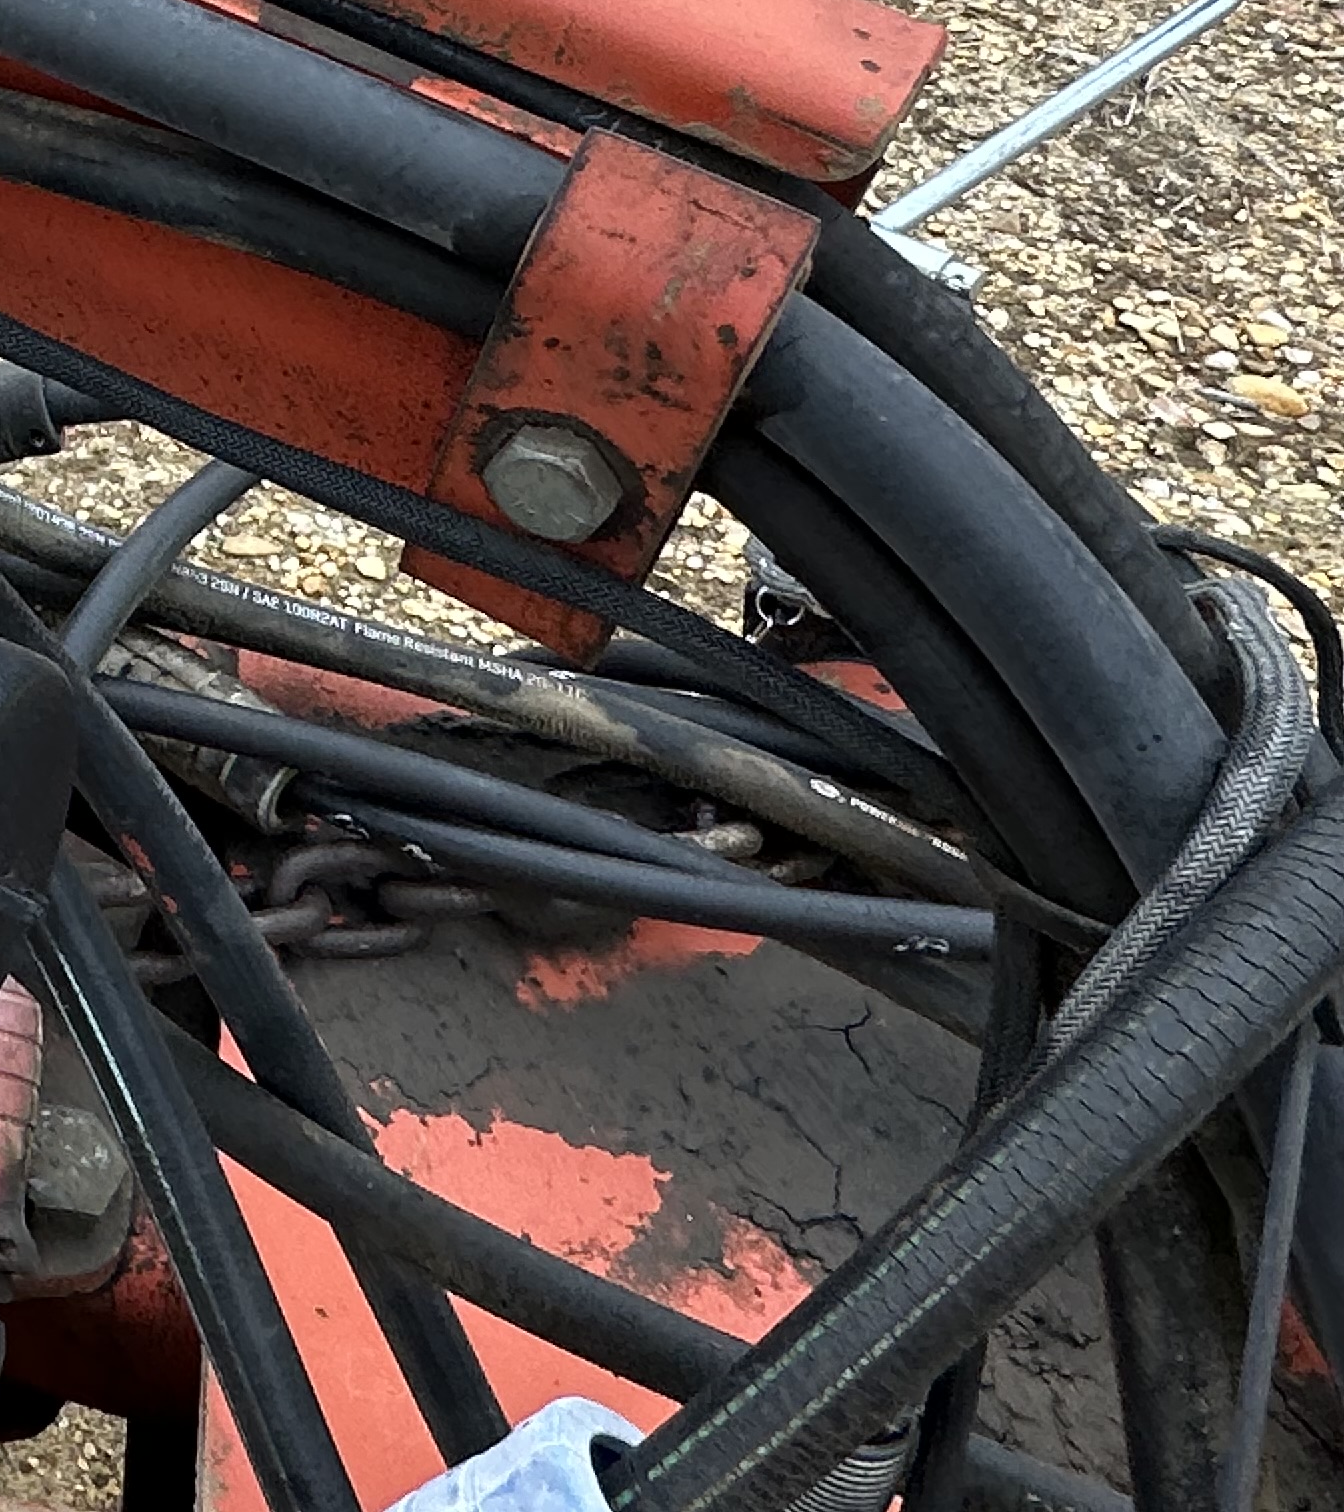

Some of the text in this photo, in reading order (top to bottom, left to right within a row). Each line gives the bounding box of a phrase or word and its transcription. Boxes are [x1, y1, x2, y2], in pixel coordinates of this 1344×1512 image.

[354, 622, 401, 646] Flame
[404, 636, 474, 668] Resistant
[478, 657, 523, 682] MSHA
